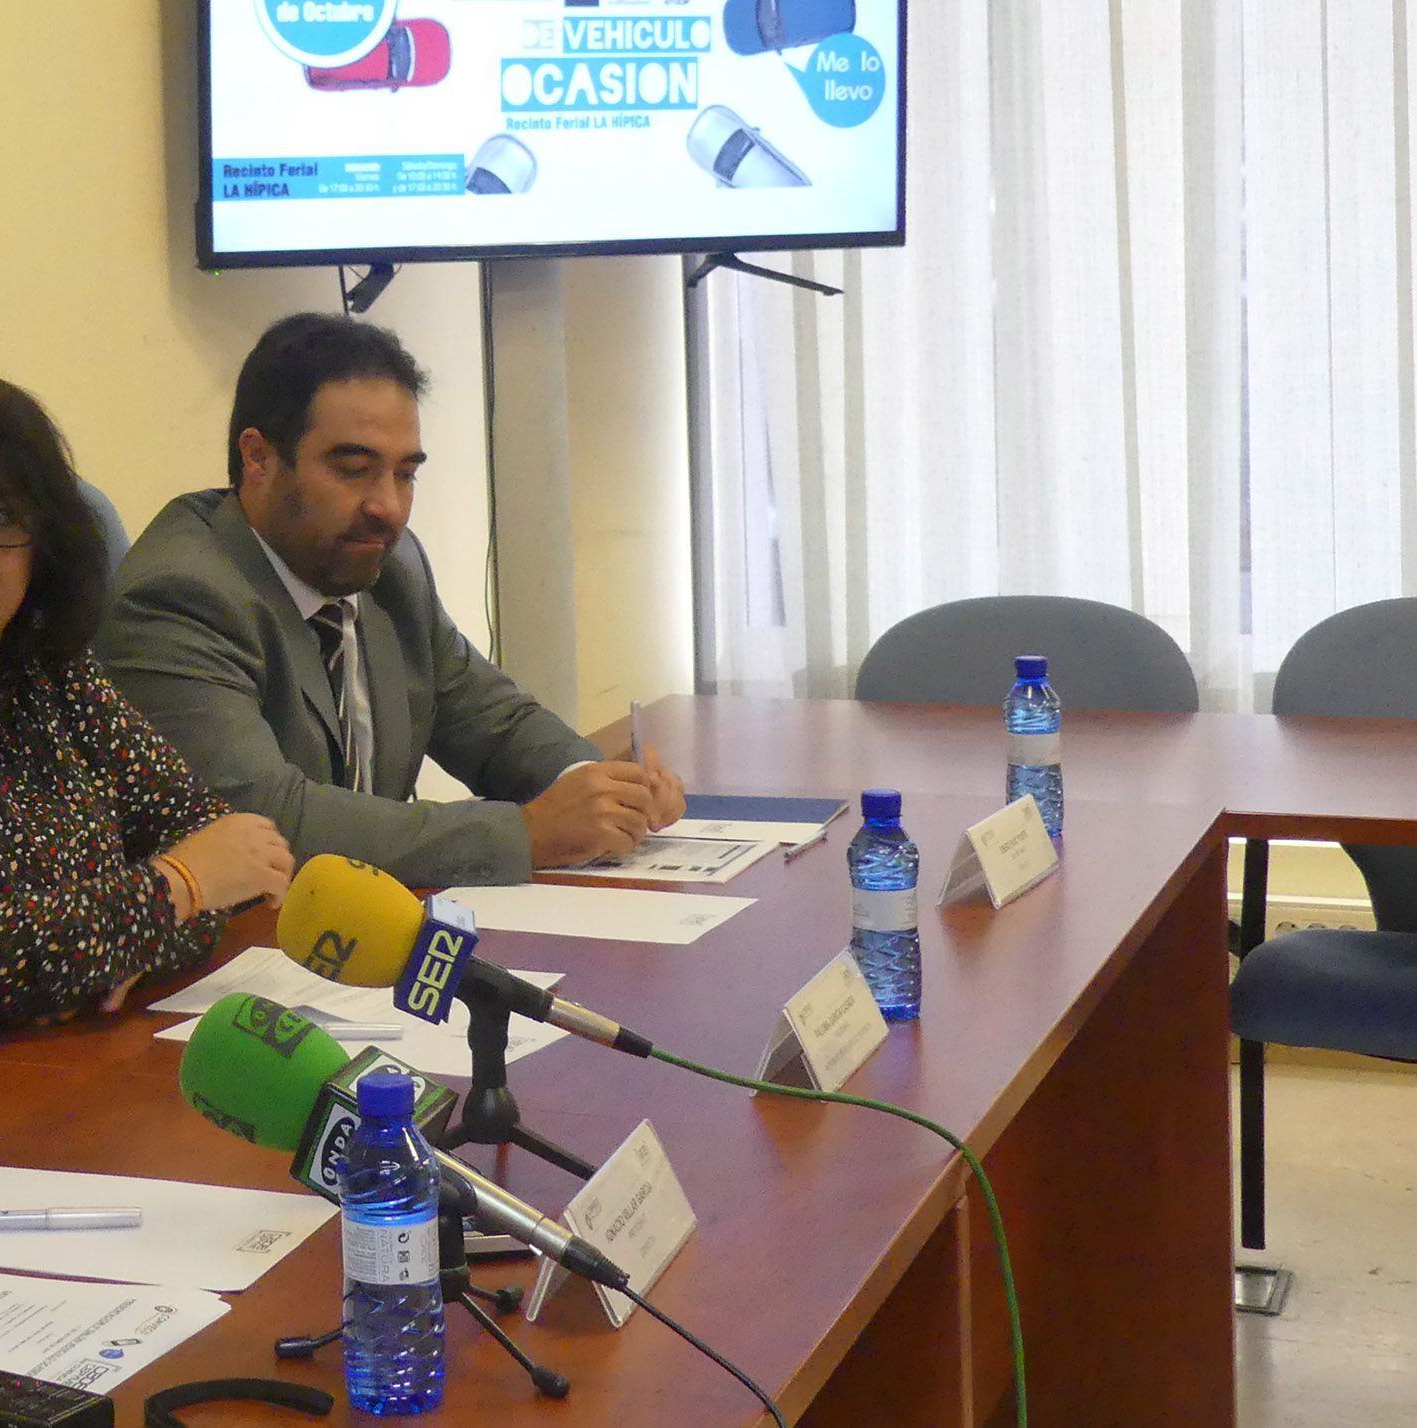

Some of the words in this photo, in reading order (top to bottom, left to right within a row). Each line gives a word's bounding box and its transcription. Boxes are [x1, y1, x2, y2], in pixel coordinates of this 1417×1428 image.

[563, 18, 711, 50] VEHICULO
[816, 50, 850, 72] Me
[861, 50, 880, 72] lo
[501, 62, 698, 107] OCASION
[824, 79, 873, 101] llevo
[506, 117, 552, 130] Recinto
[556, 115, 590, 129] Ferial
[593, 116, 607, 129] LA
[223, 164, 275, 178] Recinto
[279, 162, 318, 177] Ferial
[223, 183, 240, 198] LA
[302, 929, 358, 983] ER
[407, 929, 464, 1017] SER
[322, 1123, 354, 1181] ONDA
